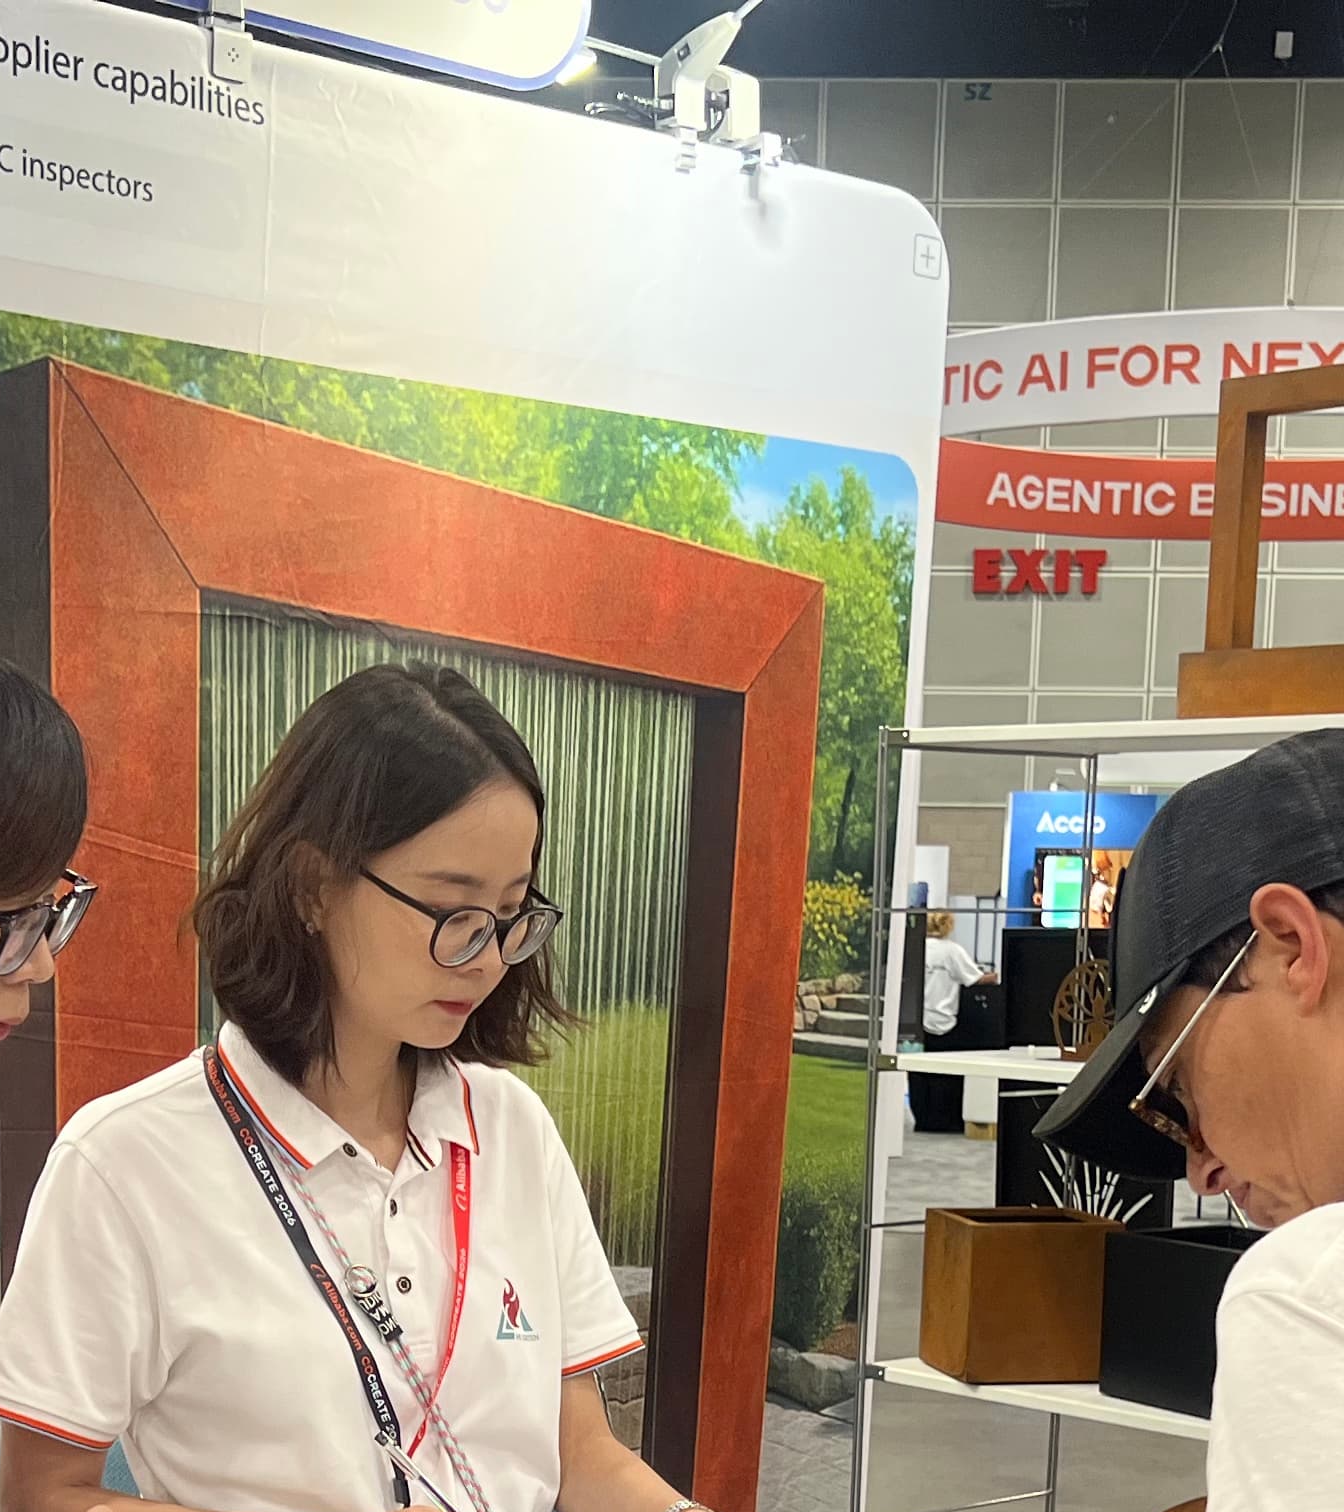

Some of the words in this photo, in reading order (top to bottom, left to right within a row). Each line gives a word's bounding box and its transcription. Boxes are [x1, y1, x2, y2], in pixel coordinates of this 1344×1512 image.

[94, 61, 265, 126] capabilities
[22, 149, 153, 203] inspectors
[1018, 351, 1069, 396] AI
[1087, 344, 1200, 389] FOR
[987, 471, 1176, 518] AGENTIC
[972, 548, 1107, 595] EXIT
[207, 1058, 241, 1125] Alibaba.com
[239, 1127, 280, 1194] COCREATE
[273, 1193, 297, 1227] 2026
[322, 1280, 364, 1352] Alibaba.com
[361, 1355, 392, 1423] COCREATE
